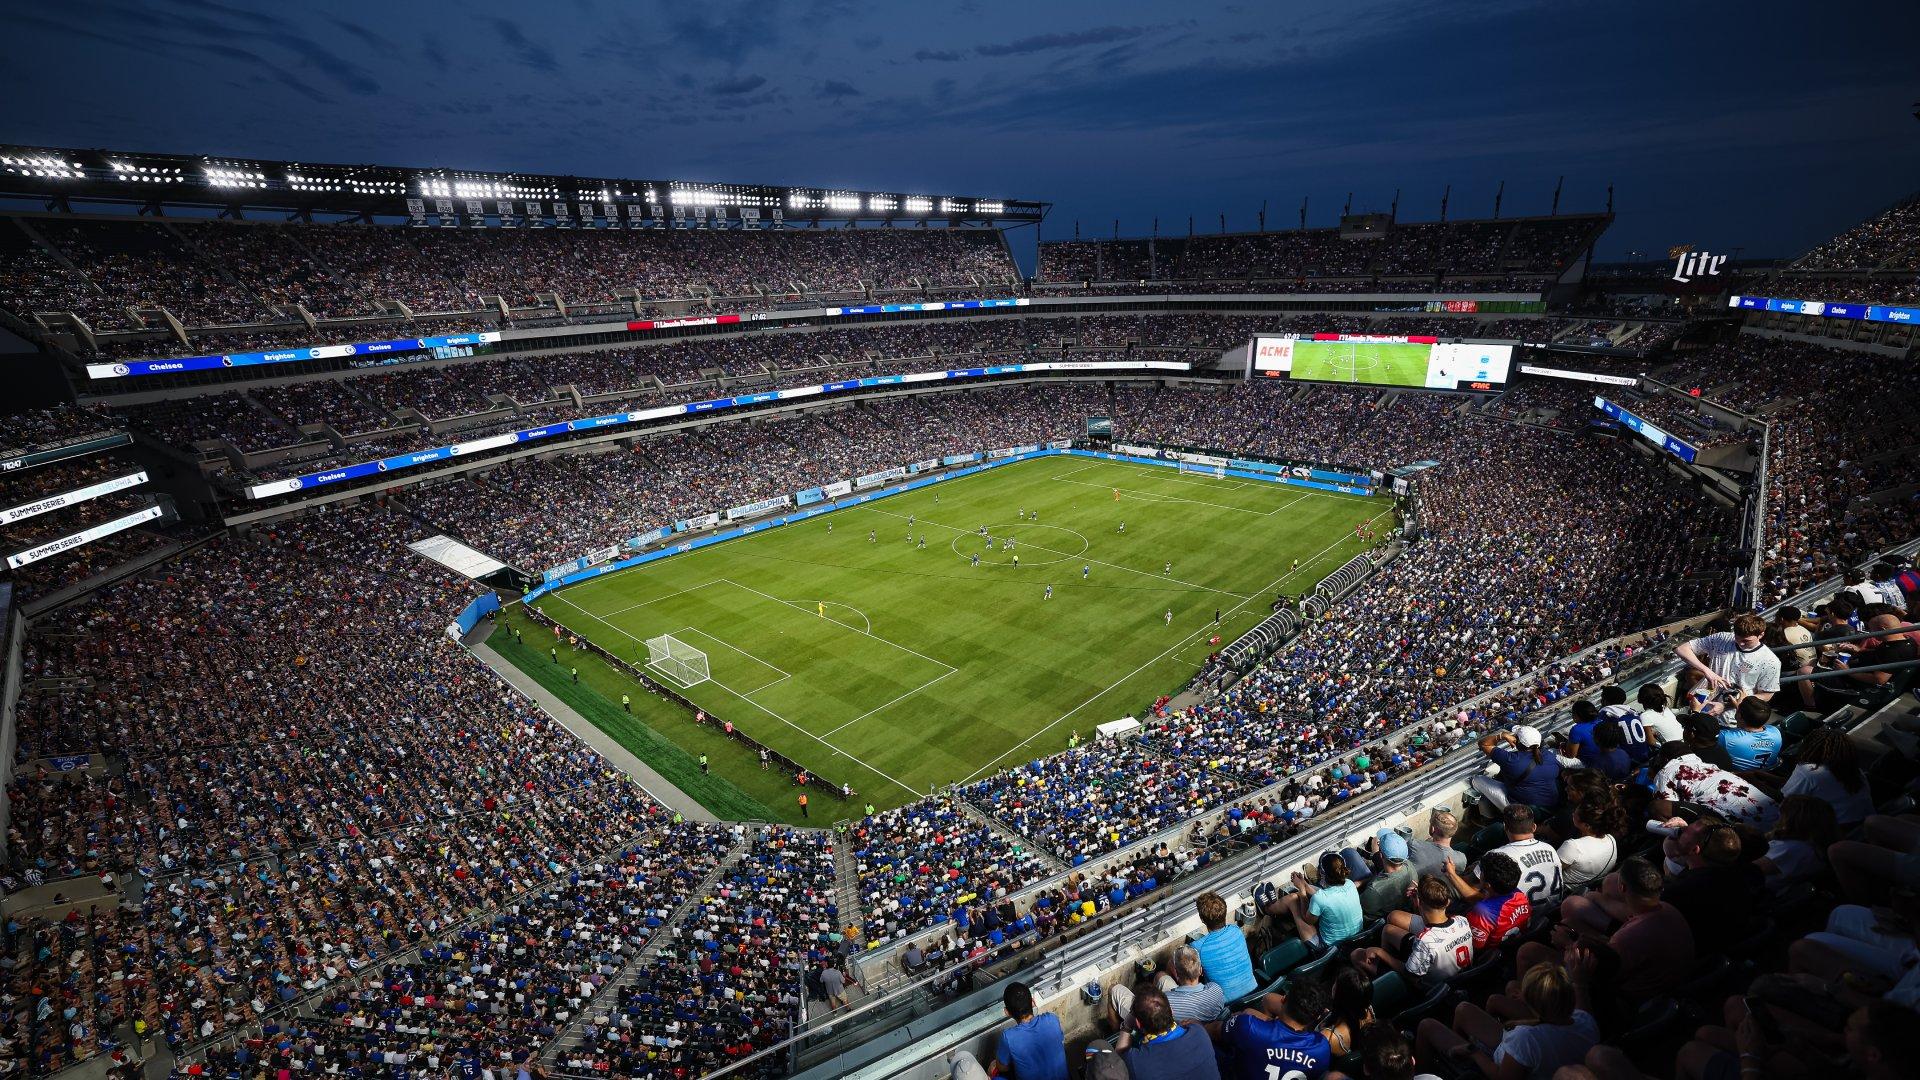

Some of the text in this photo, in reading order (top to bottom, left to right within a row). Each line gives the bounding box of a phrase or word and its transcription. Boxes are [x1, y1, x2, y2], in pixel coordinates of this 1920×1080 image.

[1672, 252, 1727, 283] Lite
[1831, 307, 1846, 315] Chelsea
[1888, 311, 1911, 320] Brighton
[661, 320, 680, 328] Lincoln
[447, 337, 469, 345] Brighton
[1260, 346, 1290, 357] ACME
[264, 353, 295, 362] Brighton
[149, 362, 183, 371] Chelsea
[753, 394, 771, 402] Brighton
[696, 402, 712, 410] Chelsea
[596, 416, 617, 425] Brighton
[528, 429, 547, 438] Chelsea
[412, 452, 438, 462] Brighton
[318, 471, 346, 482] Chelsea
[859, 469, 903, 485] PHILADELPHIA
[1275, 476, 1288, 484] FICO
[860, 495, 871, 503] FICO
[9, 503, 42, 519] SUMMER
[42, 497, 66, 510] SERIES
[730, 496, 785, 518] PHILADELPHIA
[743, 526, 755, 534] FICO
[29, 543, 60, 560] SUMMER
[61, 535, 83, 550] SERIES
[678, 543, 692, 552] FO
[600, 565, 615, 573] FICO
[1618, 719, 1646, 745] 10
[1753, 752, 1772, 769] 7
[1519, 850, 1555, 868] GRIFFEY
[1524, 866, 1562, 901] 24
[1509, 904, 1529, 925] JAMES
[1266, 1048, 1316, 1069] PULISIC
